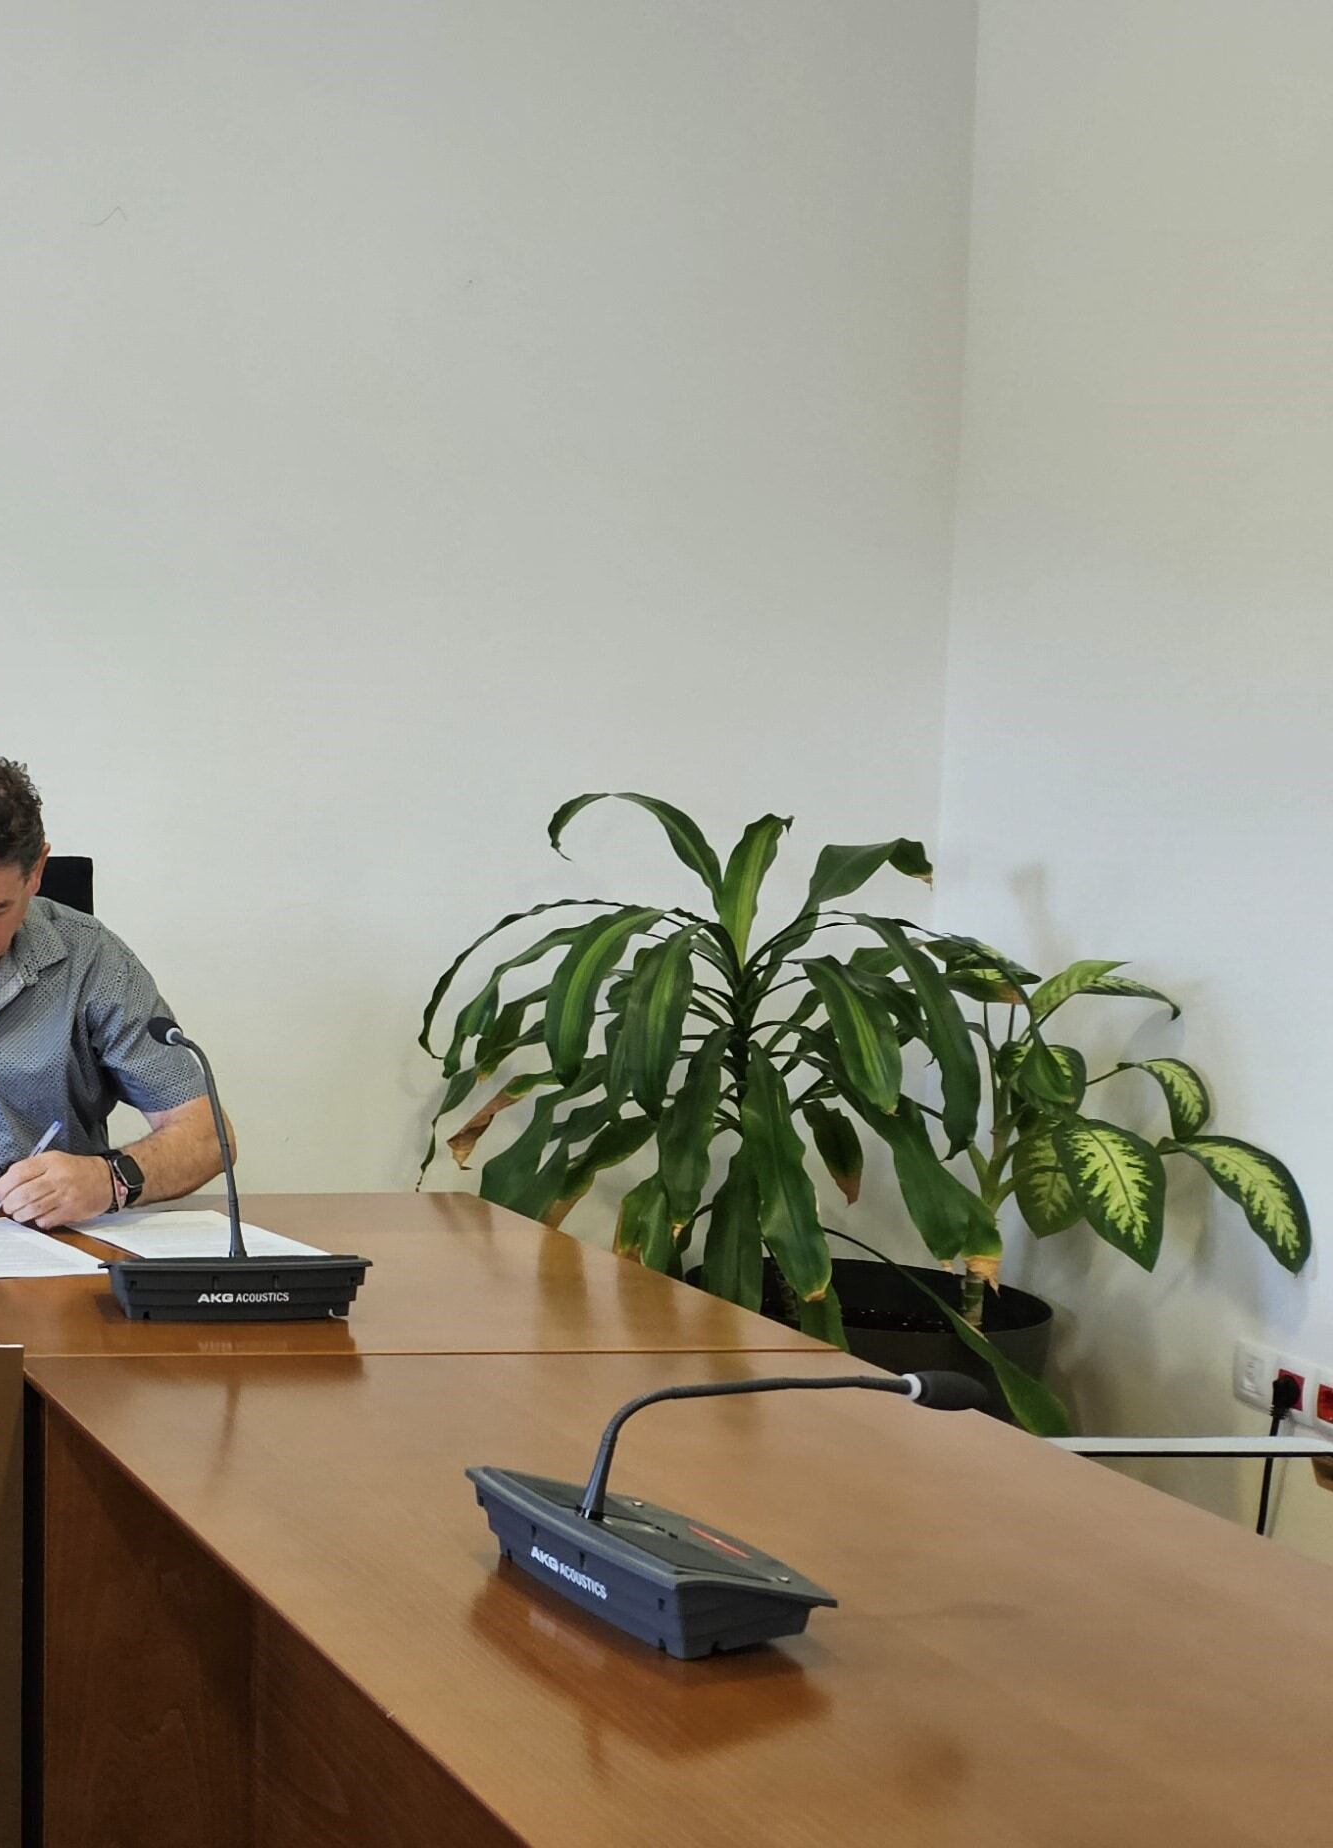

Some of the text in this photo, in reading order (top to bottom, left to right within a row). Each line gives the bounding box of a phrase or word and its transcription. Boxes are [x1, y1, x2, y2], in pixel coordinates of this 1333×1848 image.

[197, 1292, 290, 1303] AKG ACOUSTICS
[530, 1545, 608, 1600] AKG ACOUSTICS
